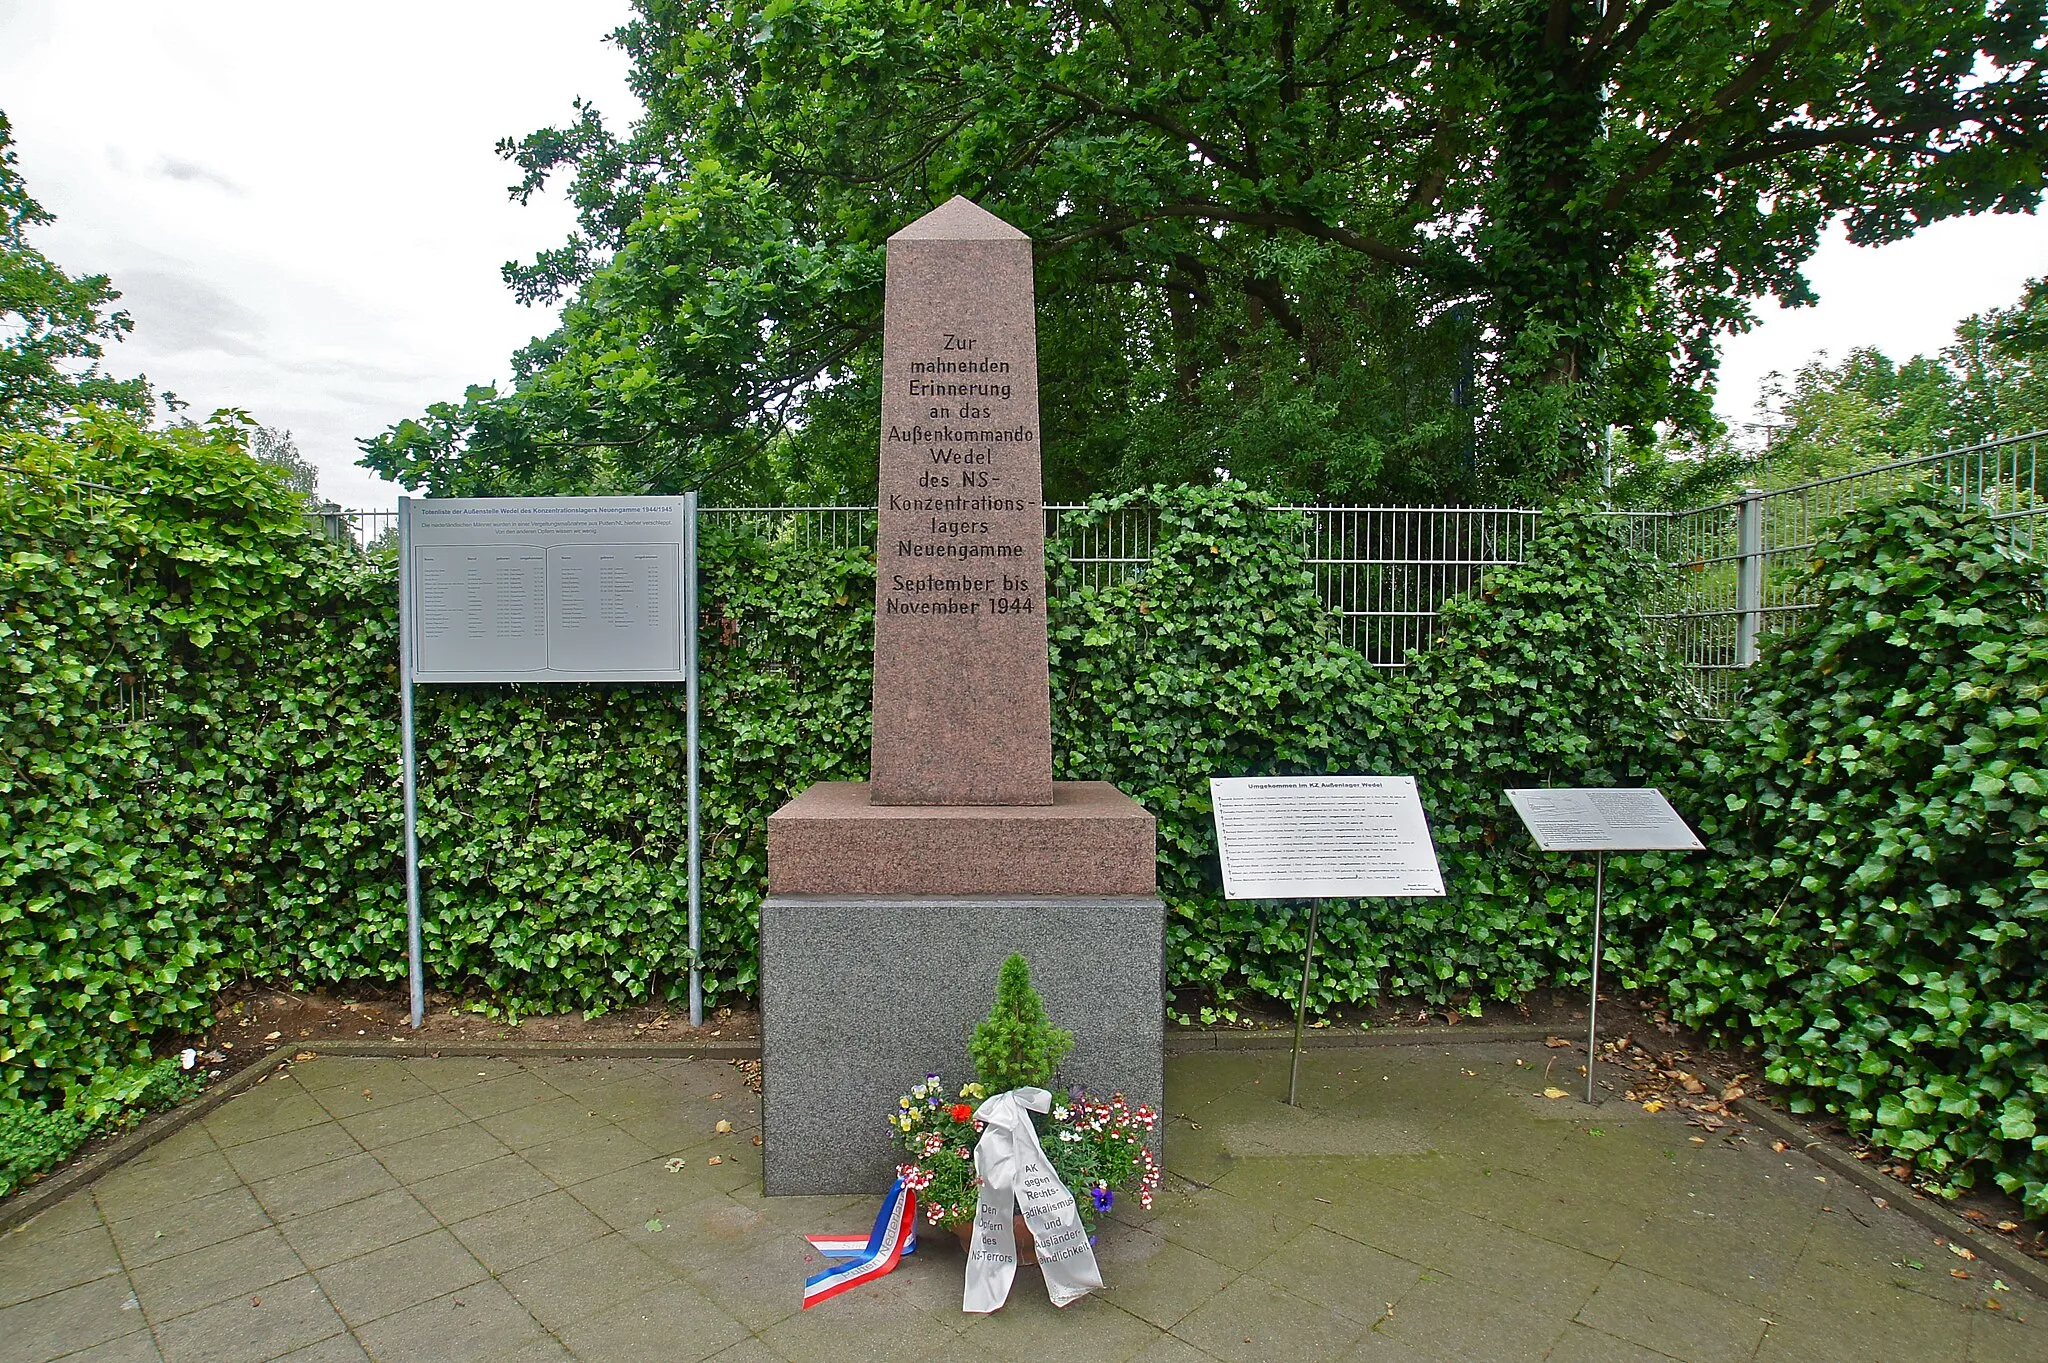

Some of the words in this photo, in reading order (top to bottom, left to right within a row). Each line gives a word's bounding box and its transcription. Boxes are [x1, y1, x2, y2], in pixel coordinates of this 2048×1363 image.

[943, 334, 977, 350] Zur
[911, 357, 1010, 373] mahnenden
[909, 380, 1011, 399] Erinnerung
[930, 406, 949, 419] an
[959, 402, 991, 419] das
[888, 425, 1033, 444] Außenkommando
[930, 448, 991, 464] Wedel
[919, 471, 949, 488] des
[962, 471, 1000, 488] NS-
[889, 494, 1036, 511] Konzentrations-
[533, 507, 598, 515] Konzentrationslagers
[932, 517, 989, 537] lagers
[898, 540, 1023, 561] Neuengamme
[892, 574, 995, 593] September
[1003, 575, 1029, 591] bis
[887, 598, 980, 614] November
[989, 598, 1034, 614] 1944
[1025, 1163, 1038, 1173] AK
[1024, 1176, 1050, 1187] gegen
[1026, 1187, 1059, 1201] Rechts-
[981, 1204, 997, 1215] Den
[978, 1217, 1003, 1231] Opfern
[1044, 1216, 1062, 1230] und
[982, 1236, 997, 1246] des
[1035, 1230, 1081, 1249] Ausländer-
[971, 1250, 1013, 1264] NS-Terrors
[1038, 1242, 1090, 1265] eindlichkeit
[841, 1259, 881, 1279] Putten
